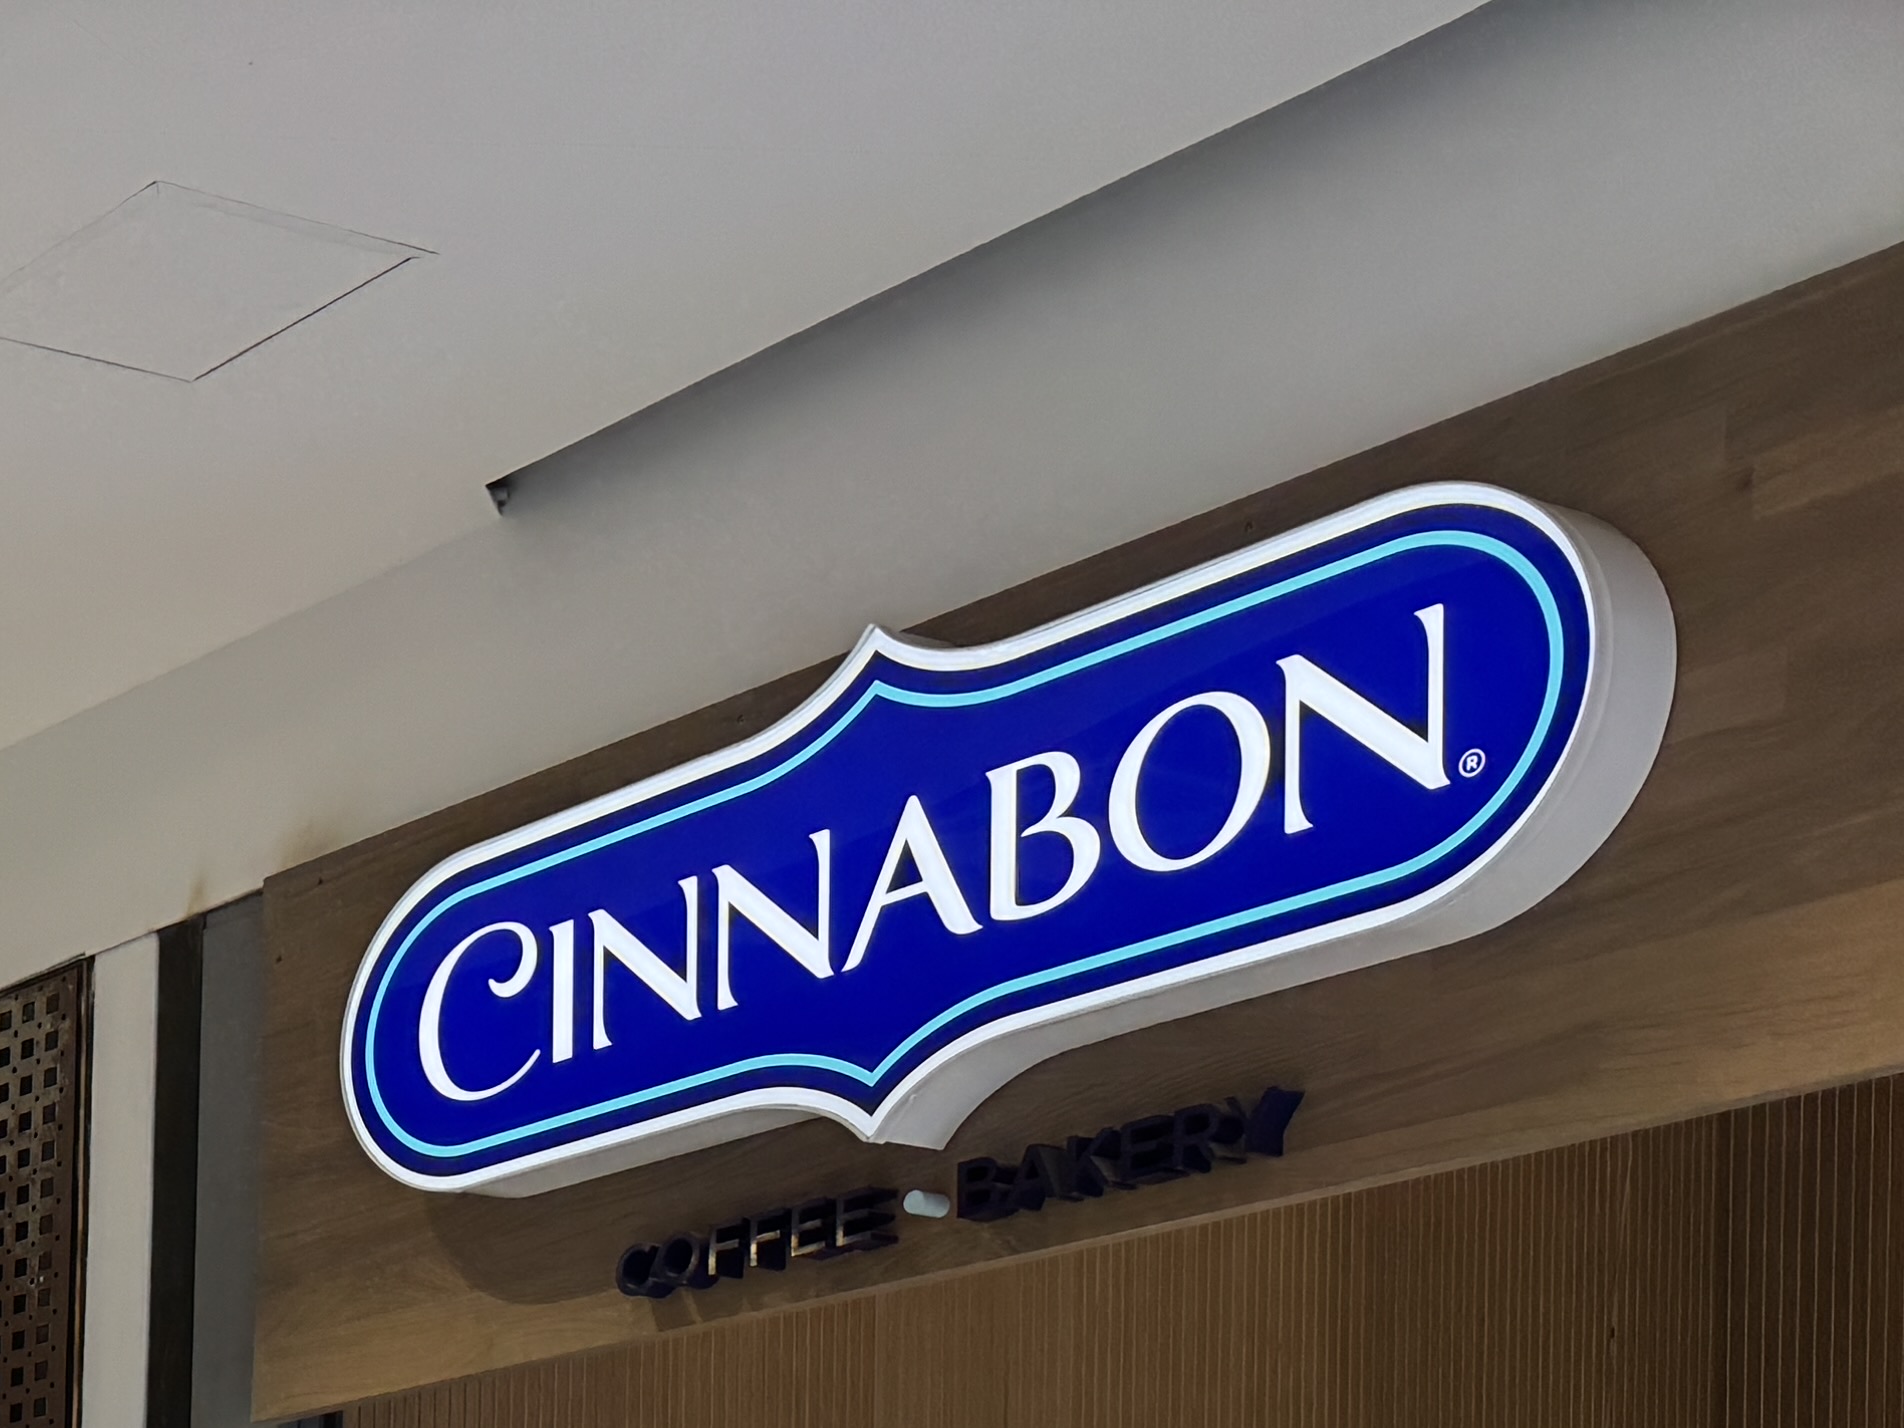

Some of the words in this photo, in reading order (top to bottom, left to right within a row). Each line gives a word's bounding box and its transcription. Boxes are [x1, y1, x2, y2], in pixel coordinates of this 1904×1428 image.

[418, 602, 1450, 1104] CINNABON
[616, 1187, 898, 1298] COFFEE
[956, 1086, 1304, 1222] BAKERY
